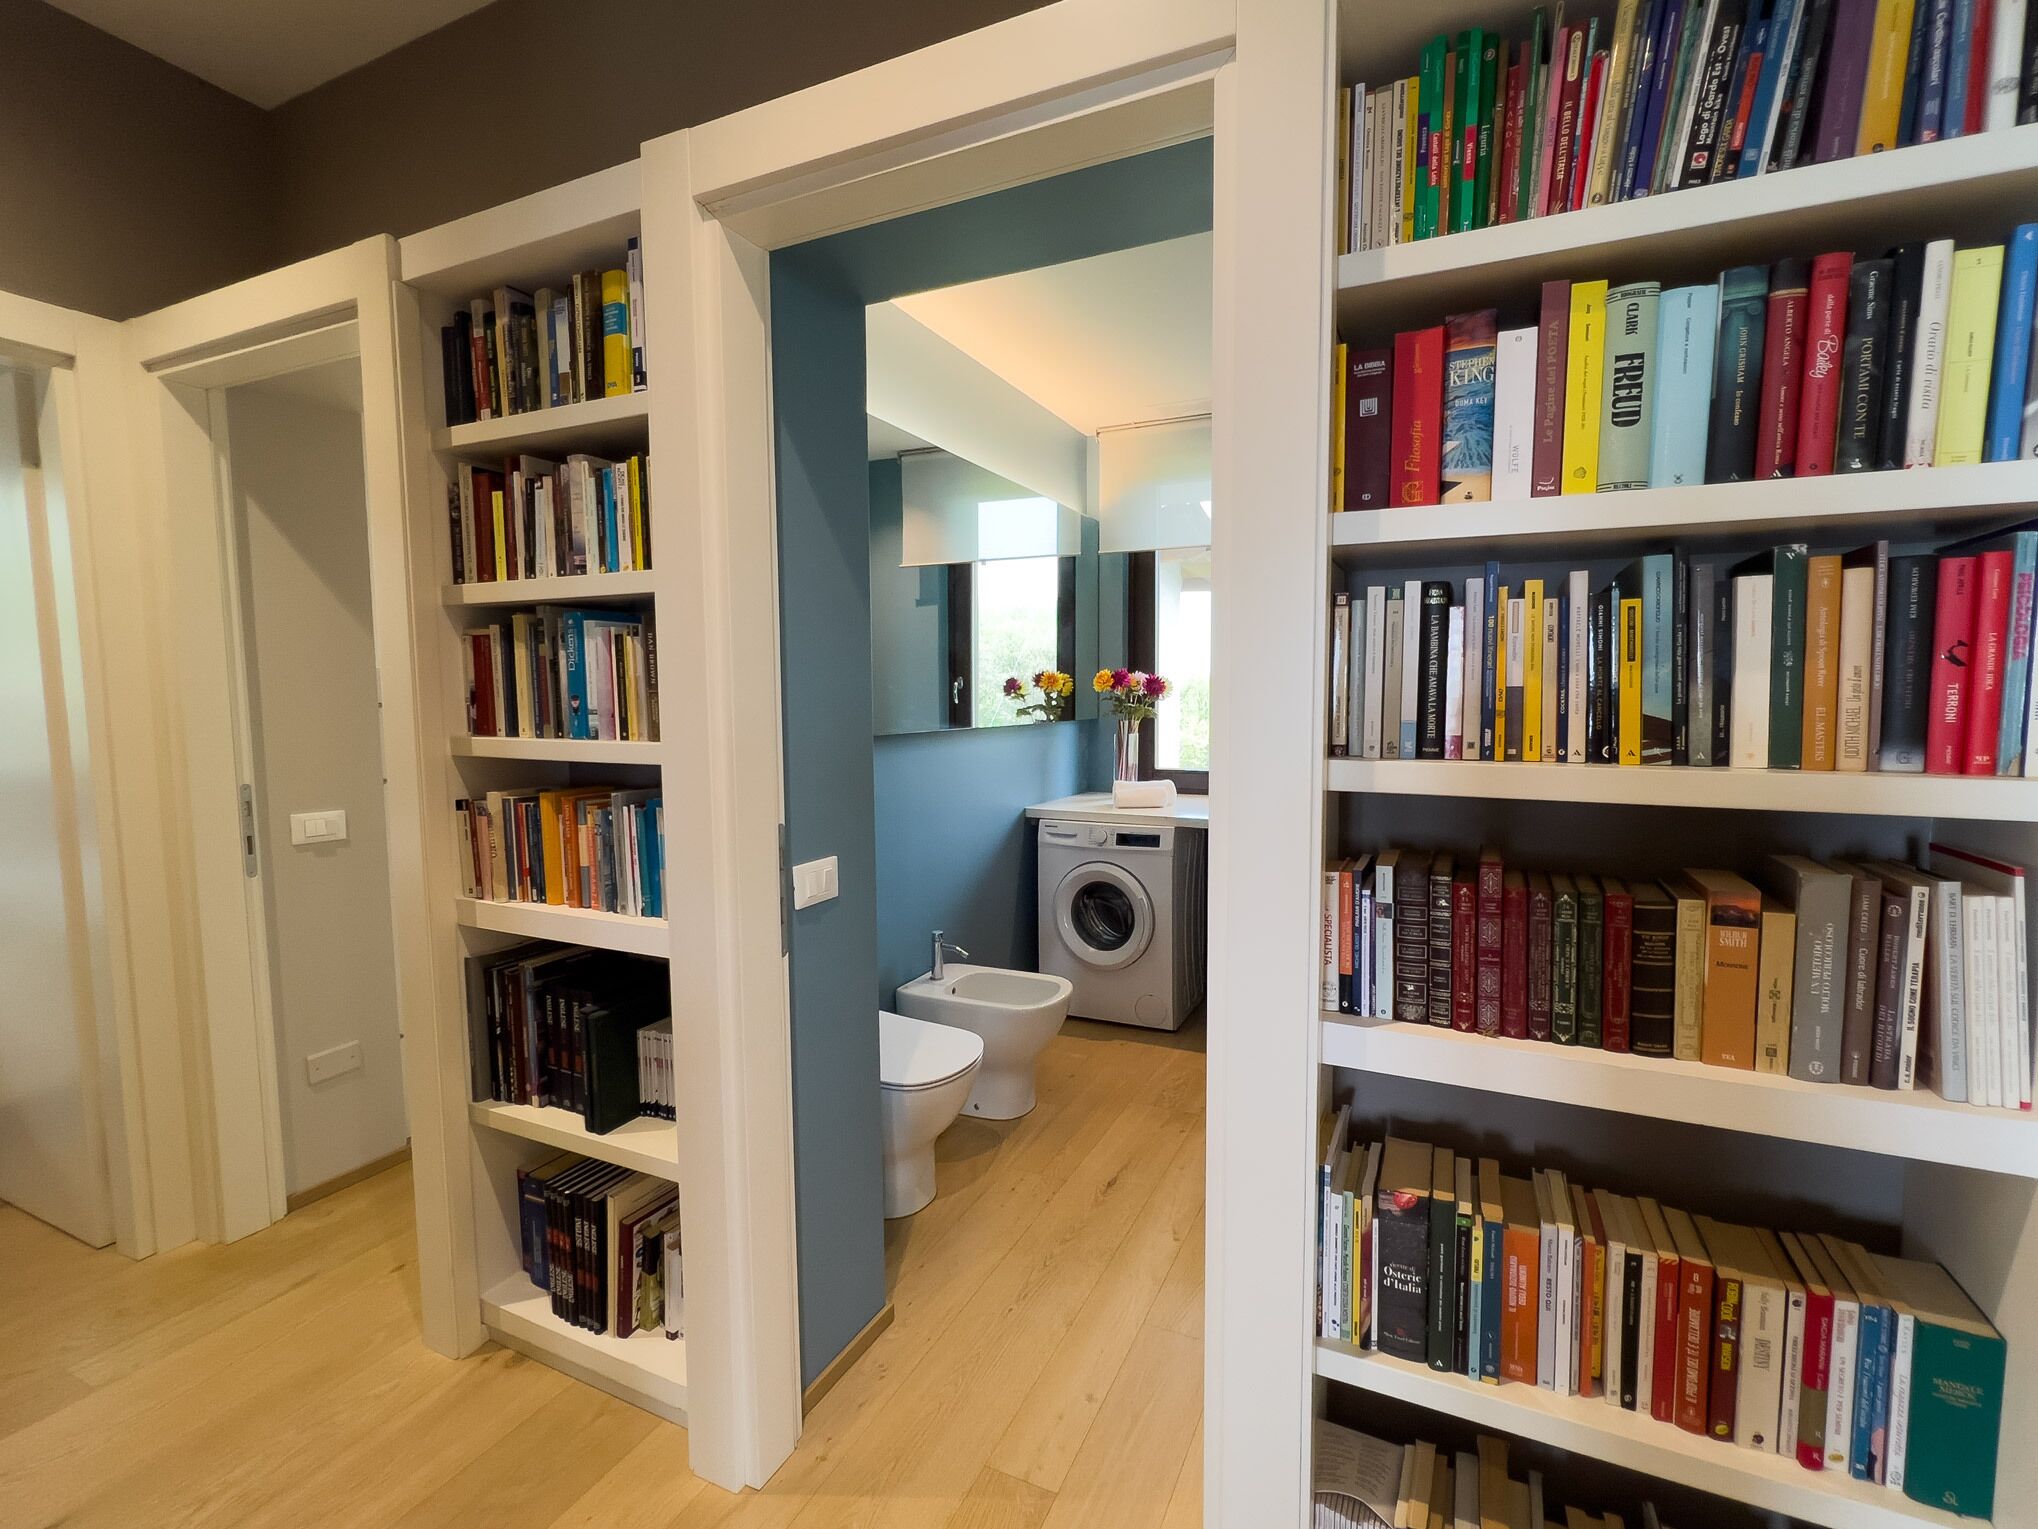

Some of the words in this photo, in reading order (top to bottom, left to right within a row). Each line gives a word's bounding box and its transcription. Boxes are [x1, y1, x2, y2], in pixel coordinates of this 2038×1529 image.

[1717, 25, 1731, 54] Ovest
[1711, 62, 1722, 76] Est
[1564, 101, 1572, 109] IL
[1704, 78, 1719, 109] Garda
[1561, 110, 1571, 135] BELLO
[1699, 111, 1711, 120] di
[1706, 111, 1720, 144] Mountain
[1713, 93, 1723, 109] bike
[1479, 124, 1491, 156] Liguria
[1696, 122, 1709, 145] Lago
[1556, 136, 1569, 180] DELL'ITALIA
[1867, 270, 1879, 300] Graeme
[1826, 294, 1835, 309] dalla
[1865, 301, 1876, 320] Sims
[1624, 302, 1640, 336] CLARK
[1784, 299, 1794, 334] ALBERTO
[1824, 310, 1833, 327] parte
[1738, 326, 1748, 346] JOHN
[1926, 321, 1944, 361] Orario
[1782, 336, 1792, 366] ANGELA
[1809, 335, 1839, 378] Bailey
[1364, 360, 1386, 369] BIBBIA
[1449, 356, 1496, 371] STEPHEN
[1736, 347, 1747, 383] GRISHAM
[1857, 337, 1874, 391] PORTAMI
[1924, 364, 1939, 377] di
[1450, 367, 1496, 387] KING
[1475, 397, 1488, 405] KEY
[1611, 352, 1646, 428] FREUD
[1919, 378, 1937, 410] visita
[1544, 387, 1556, 426] Pagine
[1733, 398, 1743, 426] confesso
[1855, 394, 1869, 422] CON
[1543, 429, 1553, 443] Le
[1853, 424, 1866, 439] TE
[1405, 420, 1423, 473] Filosofia
[1909, 567, 1920, 603] EDWARDS
[1430, 614, 1440, 625] LA
[1487, 615, 1495, 628] 100
[1815, 607, 1828, 637] Antologia
[1909, 604, 1917, 619] KIM
[2012, 572, 2033, 661] PSICOLOGIA
[1429, 626, 1440, 659] BAMBINA
[1988, 632, 1998, 642] LA
[567, 629, 575, 671] Dickens
[1596, 656, 1603, 665] LA
[1815, 647, 1826, 669] Spoon
[1986, 642, 1997, 672] GRANDE
[1428, 660, 1438, 675] CHE
[1816, 670, 1826, 687] River
[1428, 676, 1438, 702] AMAVA
[1984, 672, 1995, 690] IDEA
[1427, 703, 1437, 713] LA
[1595, 698, 1603, 730] CANCELLO
[1944, 682, 1959, 723] TERRONI
[1426, 713, 1437, 739] MORTE
[1844, 706, 1861, 735] MICHAEL
[1815, 721, 1825, 761] MASTERS
[1844, 736, 1861, 759] JUDITH
[1861, 894, 1869, 911] LIAM
[1324, 913, 1333, 966] SPECIALISTA
[1719, 937, 1747, 948] SMITH
[1822, 922, 1834, 981] PERICOLOSO
[1810, 940, 1823, 979] METODO
[1857, 948, 1869, 970] Cuore
[1949, 954, 1958, 964] LA
[1857, 971, 1868, 980] di
[1909, 962, 1920, 987] TERAPIA
[1821, 982, 1831, 1014] MOLTO
[1855, 980, 1867, 1011] labrador
[1908, 988, 1918, 1004] COME
[1950, 993, 1958, 1006] SUL
[1878, 1004, 1886, 1022] DEI
[1886, 1009, 1895, 1022] LA
[1907, 1005, 1916, 1026] SOGNO
[1875, 1023, 1885, 1063] RICORDI
[1884, 1024, 1894, 1061] STRADA
[1951, 1037, 1959, 1050] DA
[1951, 1051, 1960, 1071] VINCI
[1383, 1265, 1422, 1283] Osterie
[1383, 1277, 1422, 1295] d'Italia
[1544, 1277, 1553, 1298] RESTO
[1721, 1302, 1736, 1321] COOK
[1820, 1317, 1828, 1341] DACIA
[1753, 1338, 1771, 1371] DESTINY
[1818, 1341, 1826, 1370] MARAINI
